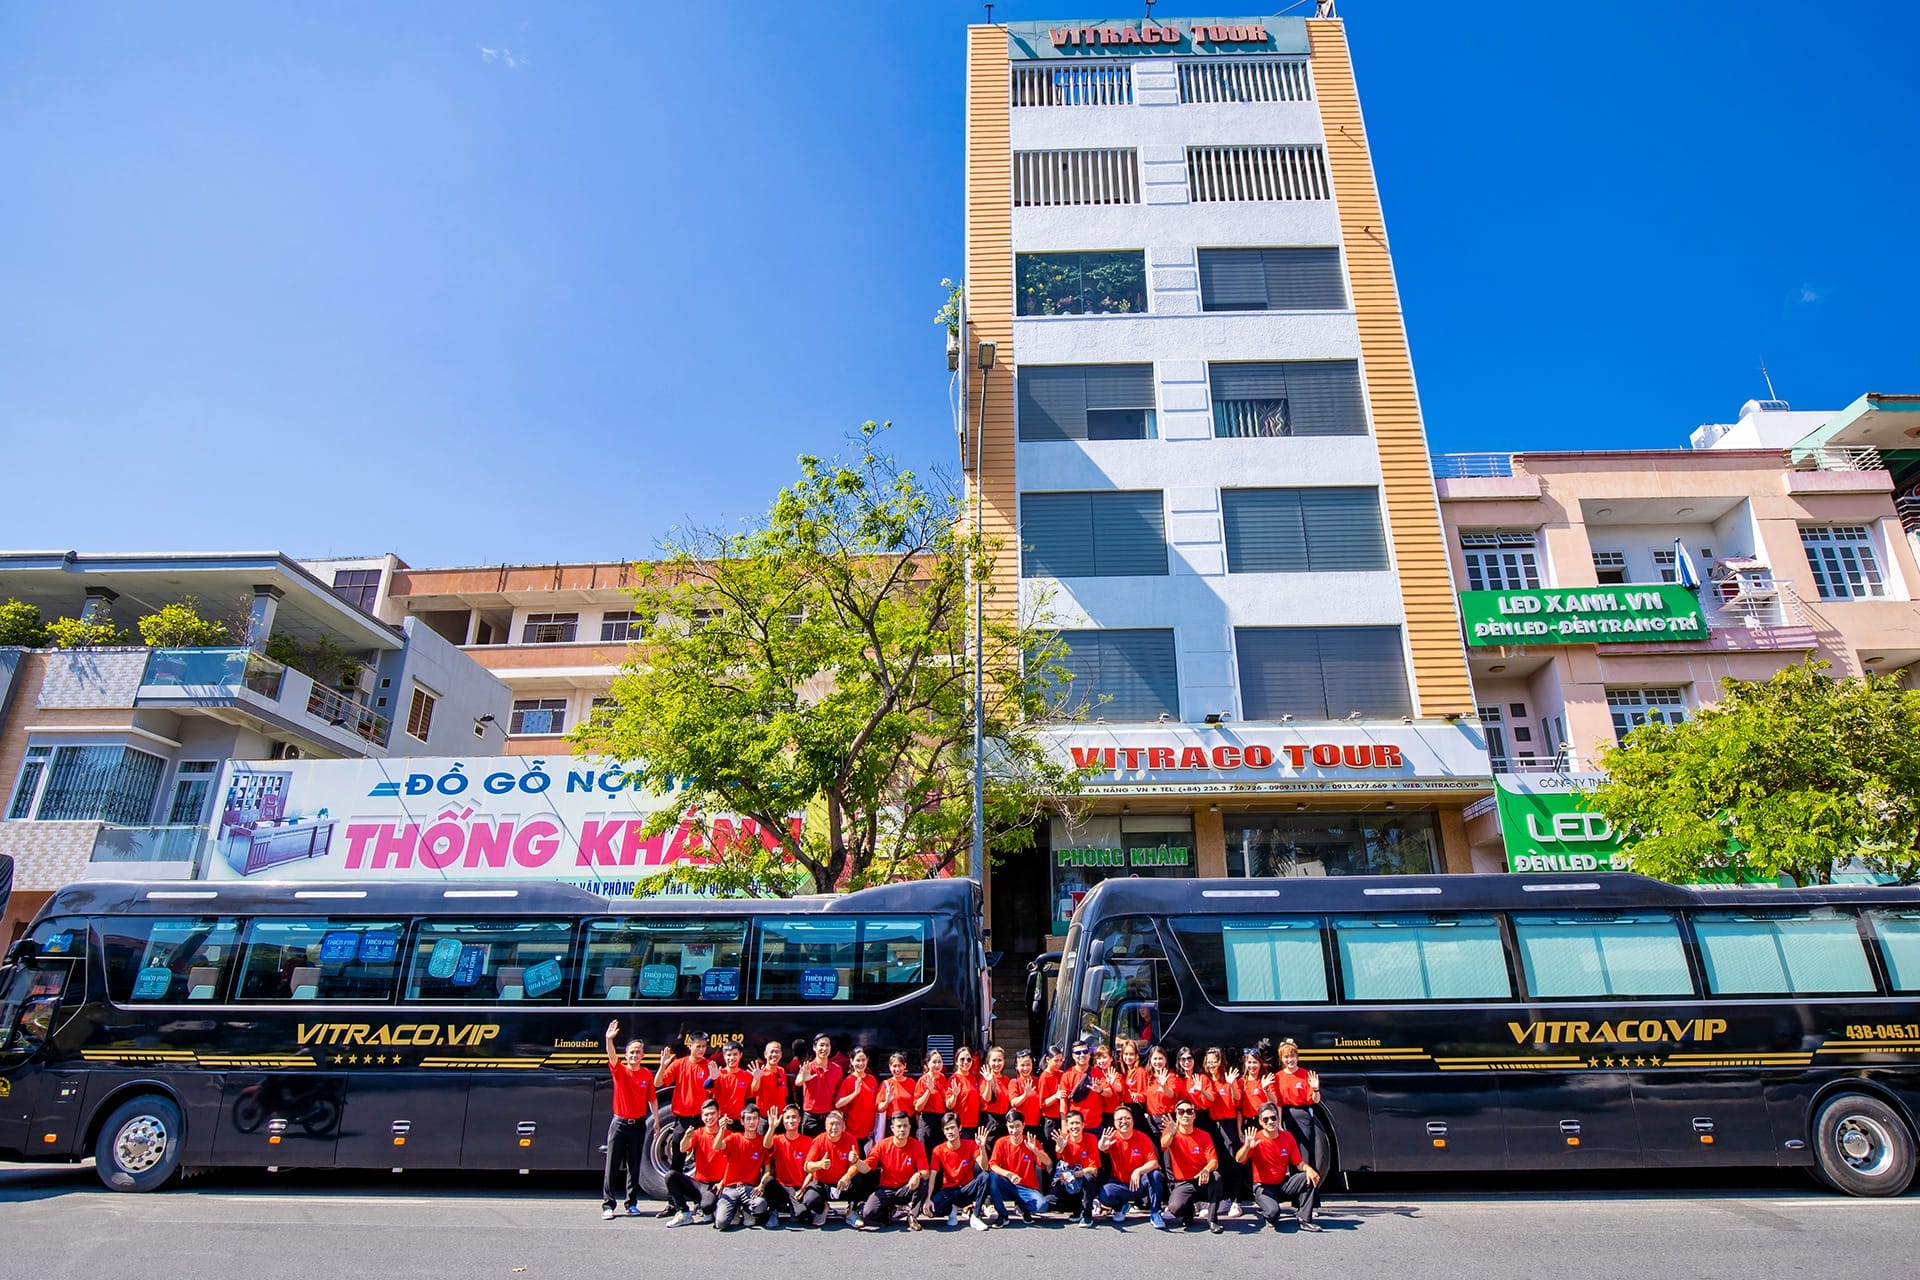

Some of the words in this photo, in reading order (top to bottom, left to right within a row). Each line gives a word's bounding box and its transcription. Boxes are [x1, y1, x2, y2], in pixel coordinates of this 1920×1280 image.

[1049, 26, 1181, 47] VITRACO
[1190, 24, 1268, 45] TOUR
[1498, 596, 1541, 614] LED
[1599, 618, 1666, 633] TRANG
[1069, 745, 1273, 771] VITRACO
[1283, 743, 1403, 769] TOUR
[405, 761, 469, 796] ĐỒ
[483, 759, 551, 794] GỖ
[343, 806, 561, 870] THỐNG
[1526, 812, 1614, 842] LED
[1058, 844, 1124, 867] PHÒNG
[297, 1023, 500, 1046] VITRACO.VIP
[1334, 1037, 1381, 1047] Limousine
[1507, 1018, 1728, 1044] VITRACO.VIP
[1846, 1024, 1919, 1040] 43B-045.17
[554, 1038, 598, 1048] Limousine
